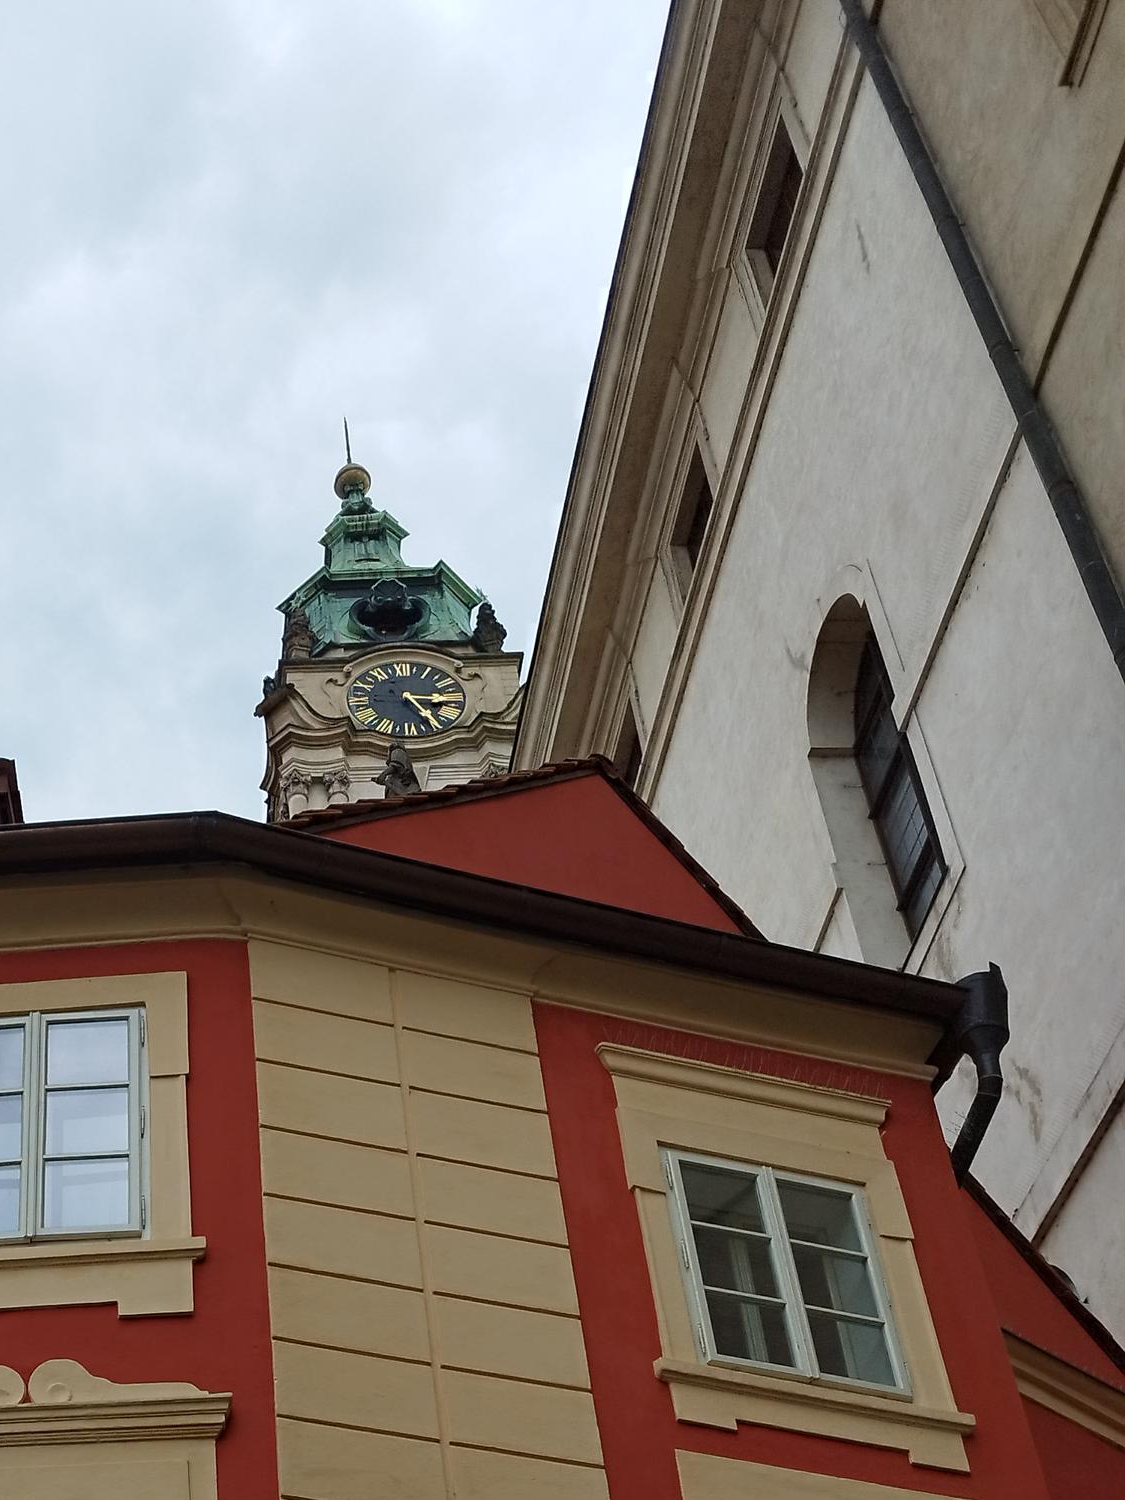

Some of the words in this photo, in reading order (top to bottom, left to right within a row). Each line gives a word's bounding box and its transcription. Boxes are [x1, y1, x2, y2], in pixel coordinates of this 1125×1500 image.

[369, 667, 389, 682] XI
[393, 663, 411, 677] XII
[353, 680, 375, 692] X
[435, 677, 456, 689] II
[347, 696, 369, 705] IX
[354, 707, 379, 725] VIII
[375, 718, 394, 734] VII
[404, 722, 418, 736] VI
